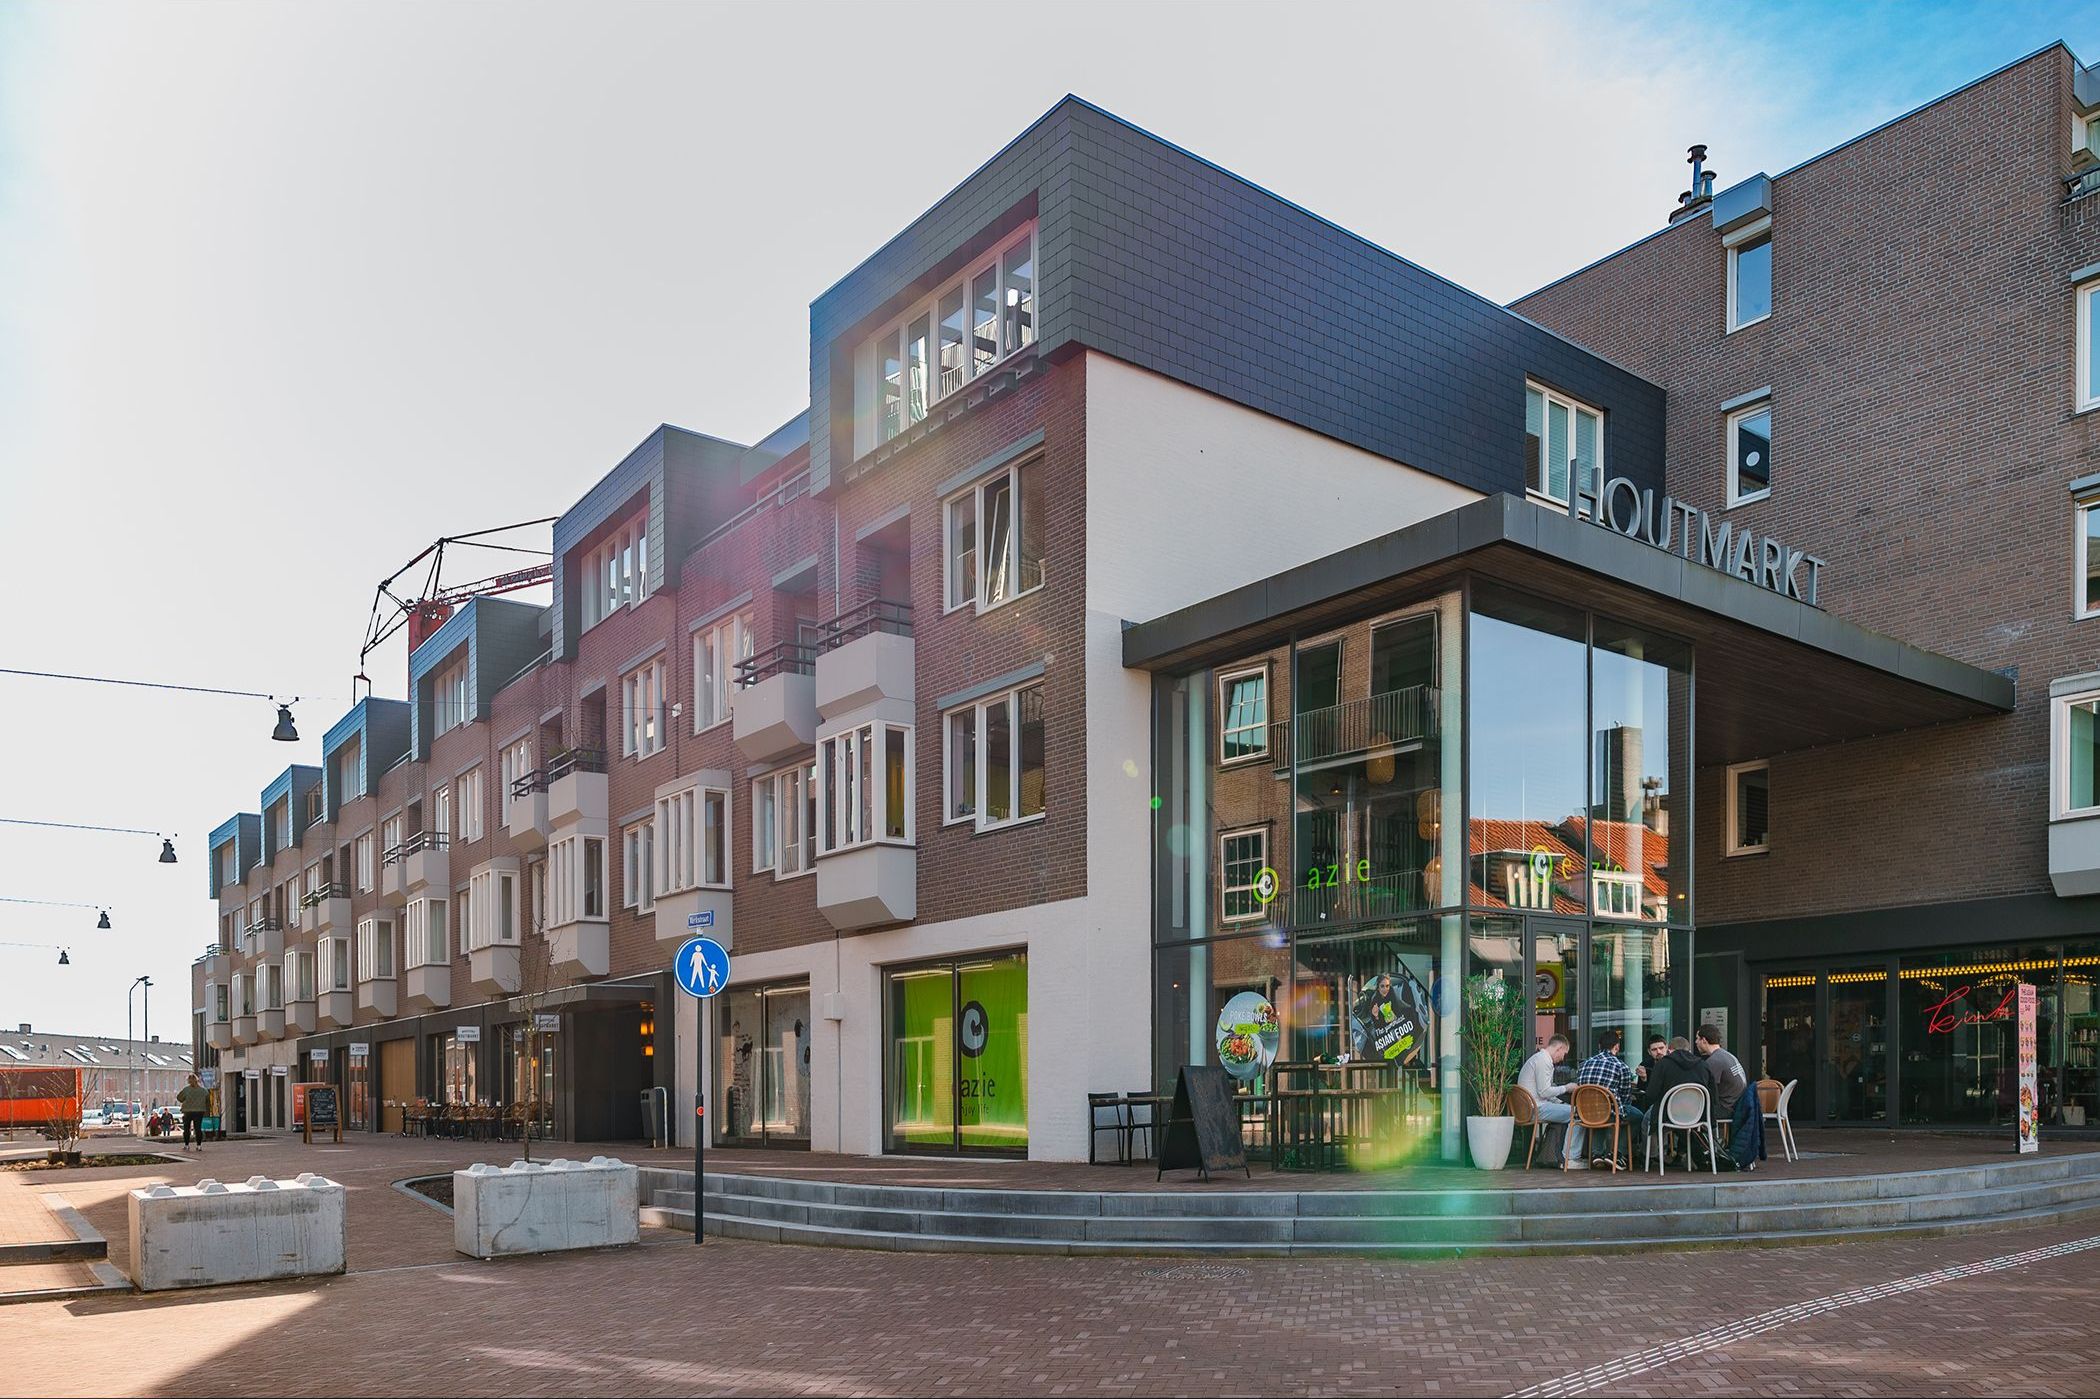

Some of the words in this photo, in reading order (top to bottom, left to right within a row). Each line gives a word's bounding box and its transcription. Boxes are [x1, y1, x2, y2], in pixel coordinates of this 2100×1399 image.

[1569, 459, 1828, 605] HOUTMARKT
[1307, 852, 1370, 890] azie
[1561, 853, 1624, 884] ezie
[1374, 1031, 1395, 1052] ASIAN
[1394, 1020, 1414, 1039] FOOD
[957, 1071, 996, 1098] azie
